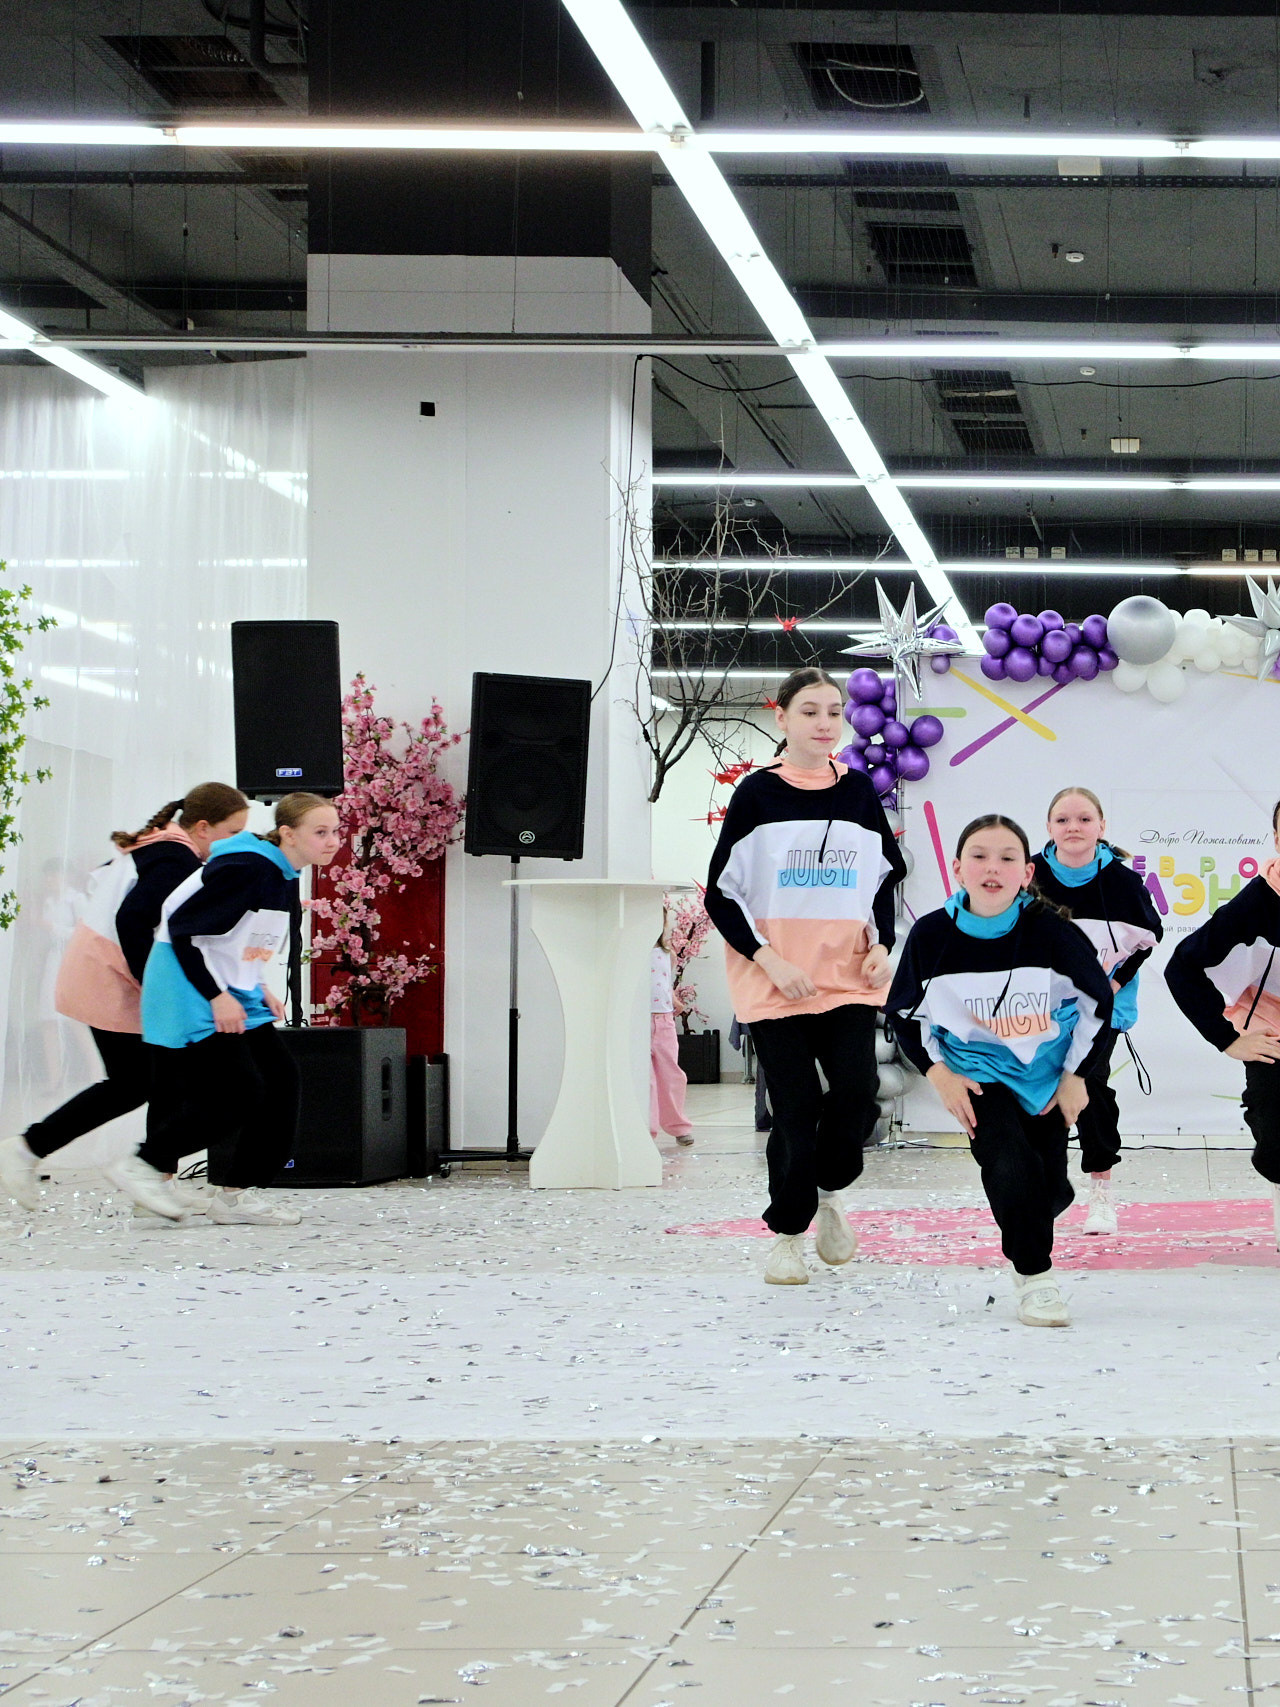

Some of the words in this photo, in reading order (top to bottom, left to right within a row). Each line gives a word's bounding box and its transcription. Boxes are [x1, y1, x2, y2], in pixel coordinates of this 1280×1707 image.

[1139, 829, 1180, 847] Добро
[1182, 829, 1269, 846] Пожаловать!
[780, 849, 858, 887] JUICY
